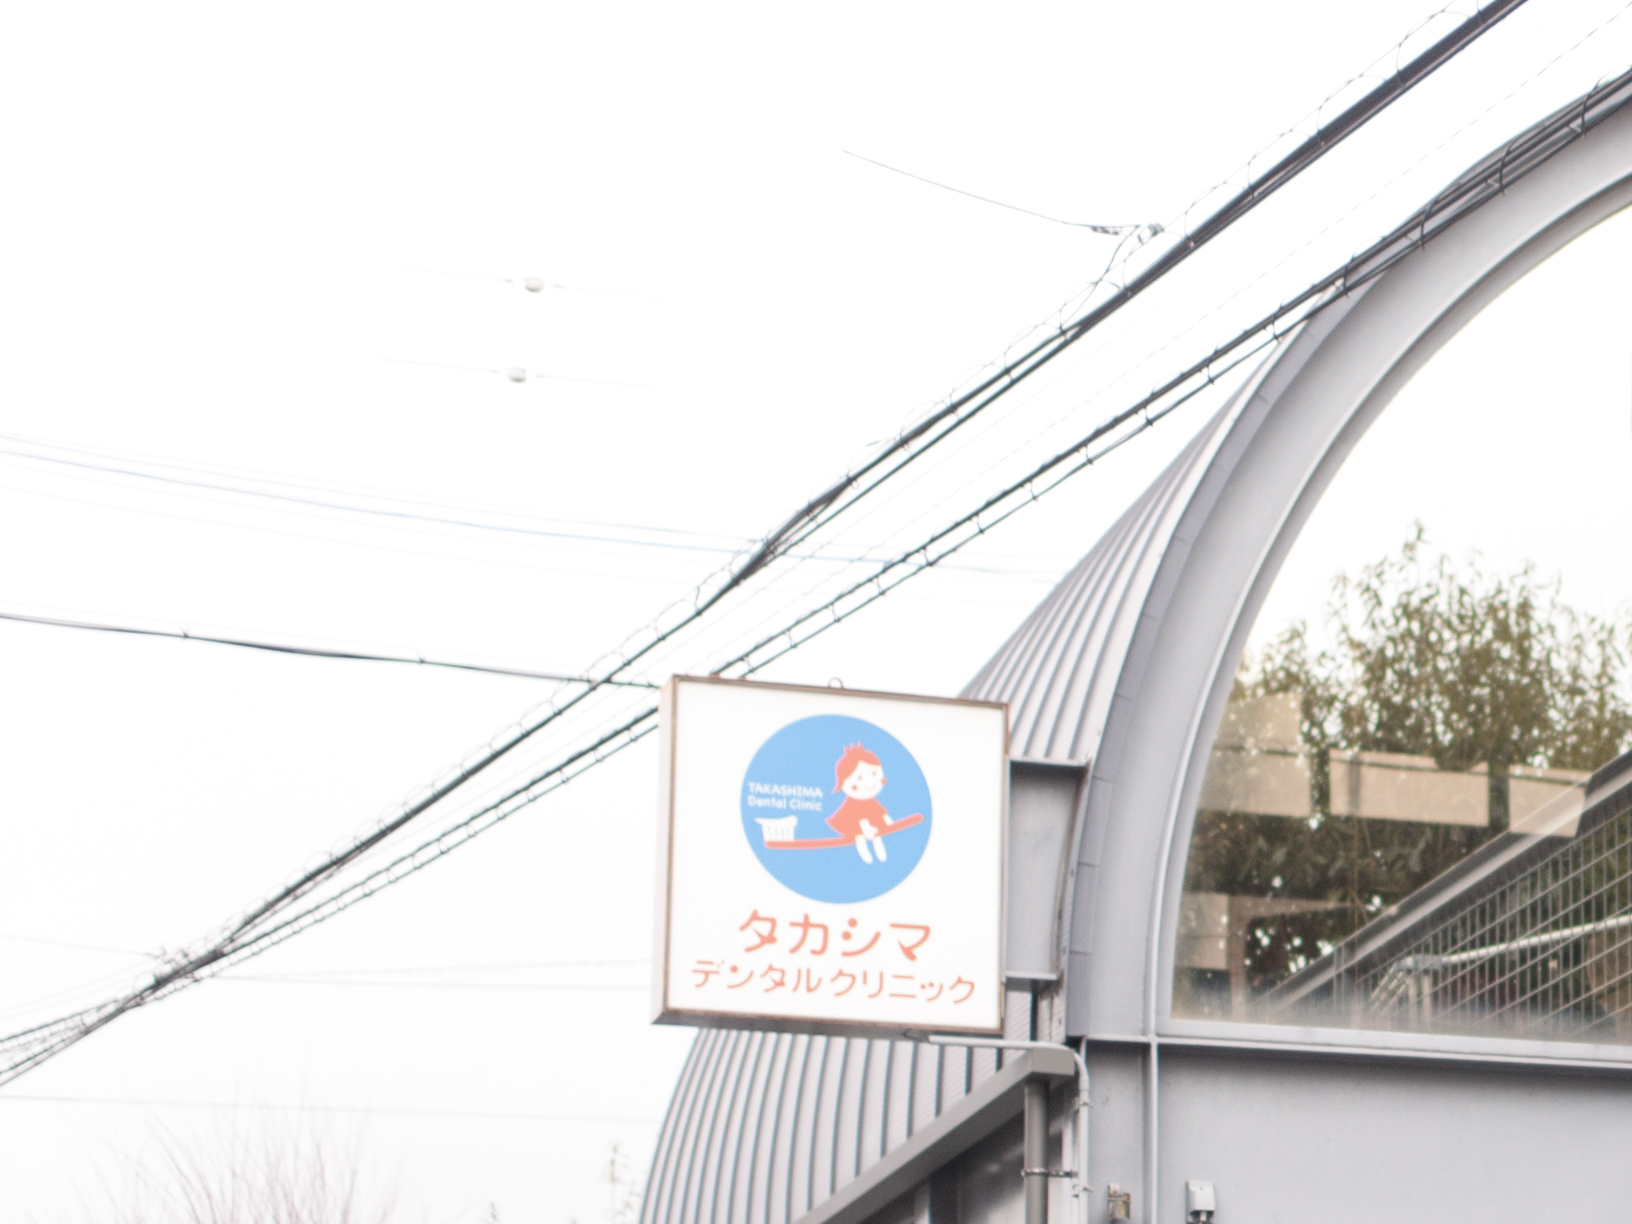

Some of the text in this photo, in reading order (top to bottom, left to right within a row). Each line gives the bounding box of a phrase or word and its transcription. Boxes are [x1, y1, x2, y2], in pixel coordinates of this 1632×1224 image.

[747, 794, 822, 812] Dental Clinic
[748, 781, 823, 799] TAKASHIMA
[738, 909, 932, 962] タカシマ
[691, 959, 976, 1005] デンタルクリニック
